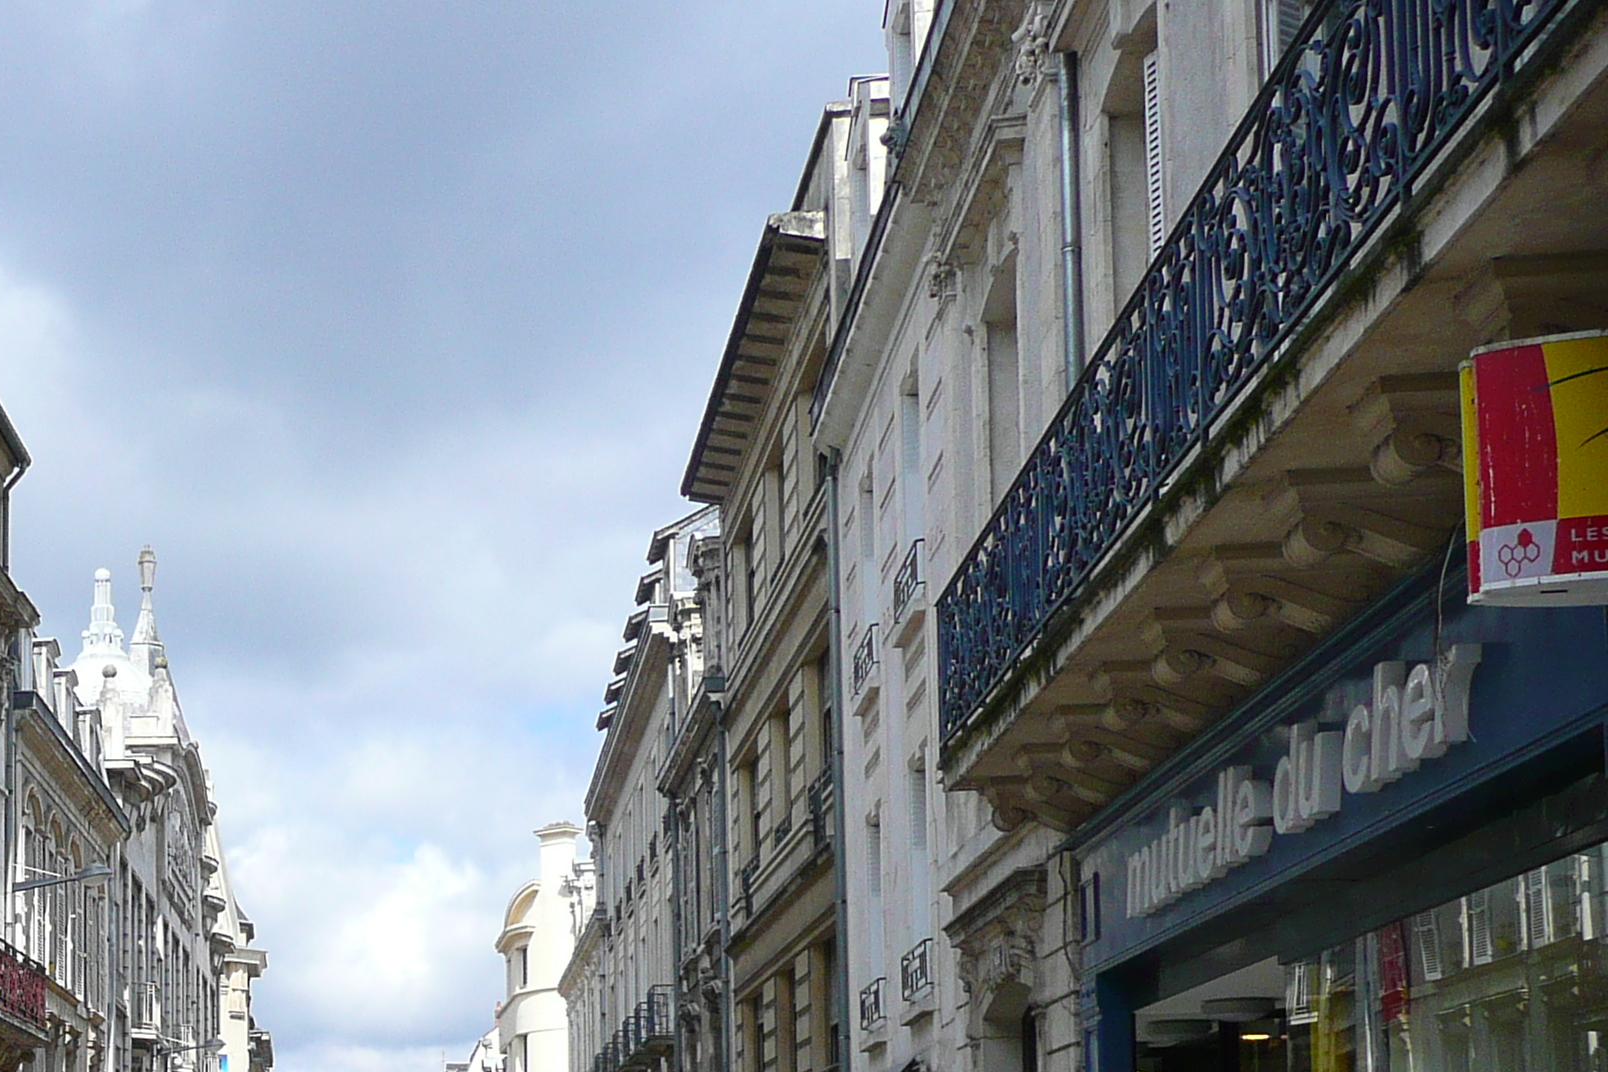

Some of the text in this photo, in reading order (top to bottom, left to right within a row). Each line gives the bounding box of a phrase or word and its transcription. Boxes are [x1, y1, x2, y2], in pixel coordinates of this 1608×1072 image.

[1126, 643, 1482, 918] mutuelle du cher
